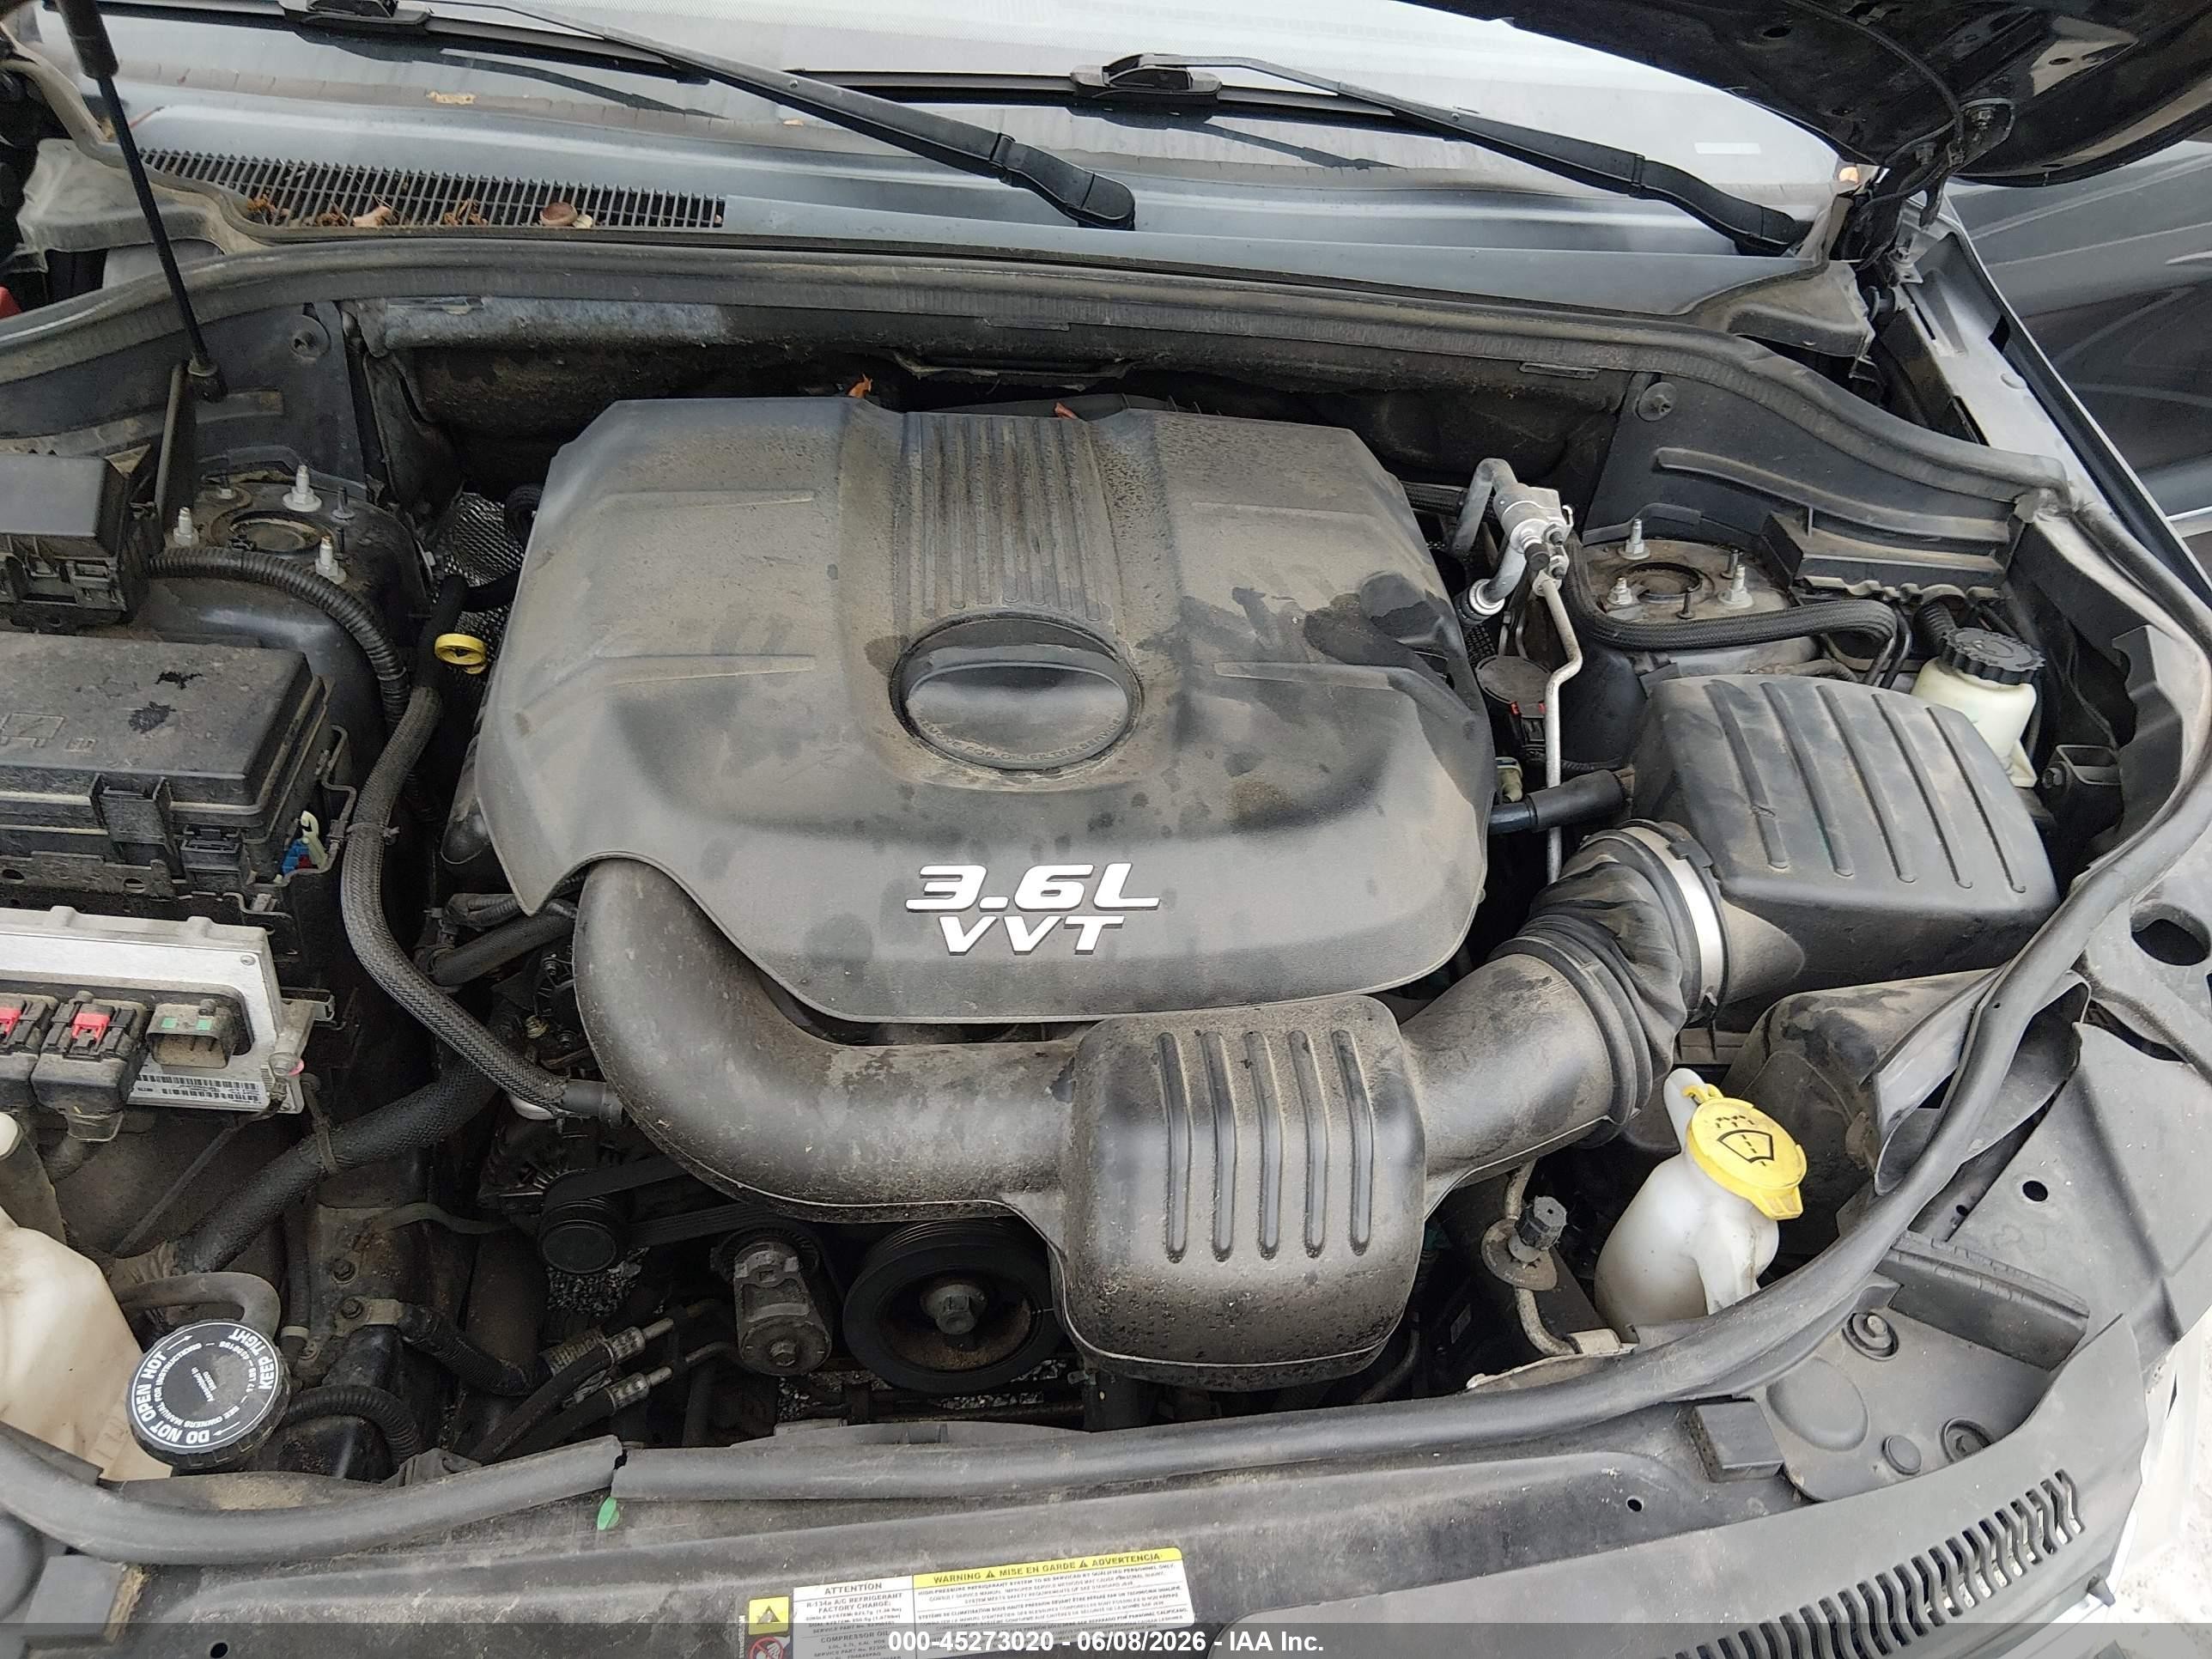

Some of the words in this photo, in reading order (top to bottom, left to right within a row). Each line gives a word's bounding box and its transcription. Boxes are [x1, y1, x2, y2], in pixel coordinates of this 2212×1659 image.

[905, 862, 1160, 912] 3.6L
[939, 915, 1125, 955] VVT
[228, 1328, 267, 1356] TIGHT
[140, 1351, 167, 1379] HOT
[155, 1342, 203, 1385] INSTRUCTIONS
[258, 1357, 275, 1389] KEEP
[136, 1383, 156, 1422] OPEN
[154, 1386, 163, 1402] FOR
[157, 1401, 184, 1425] MANUAL
[149, 1420, 183, 1443] NOT
[185, 1430, 210, 1444] DO
[933, 1571, 981, 1584] WARNING
[1000, 1567, 1023, 1577] MISE
[1026, 1565, 1039, 1574] EN
[1042, 1561, 1076, 1572] GARDE
[1092, 1553, 1160, 1567] ADVERTENCIA
[824, 1583, 883, 1595] ATTENTION
